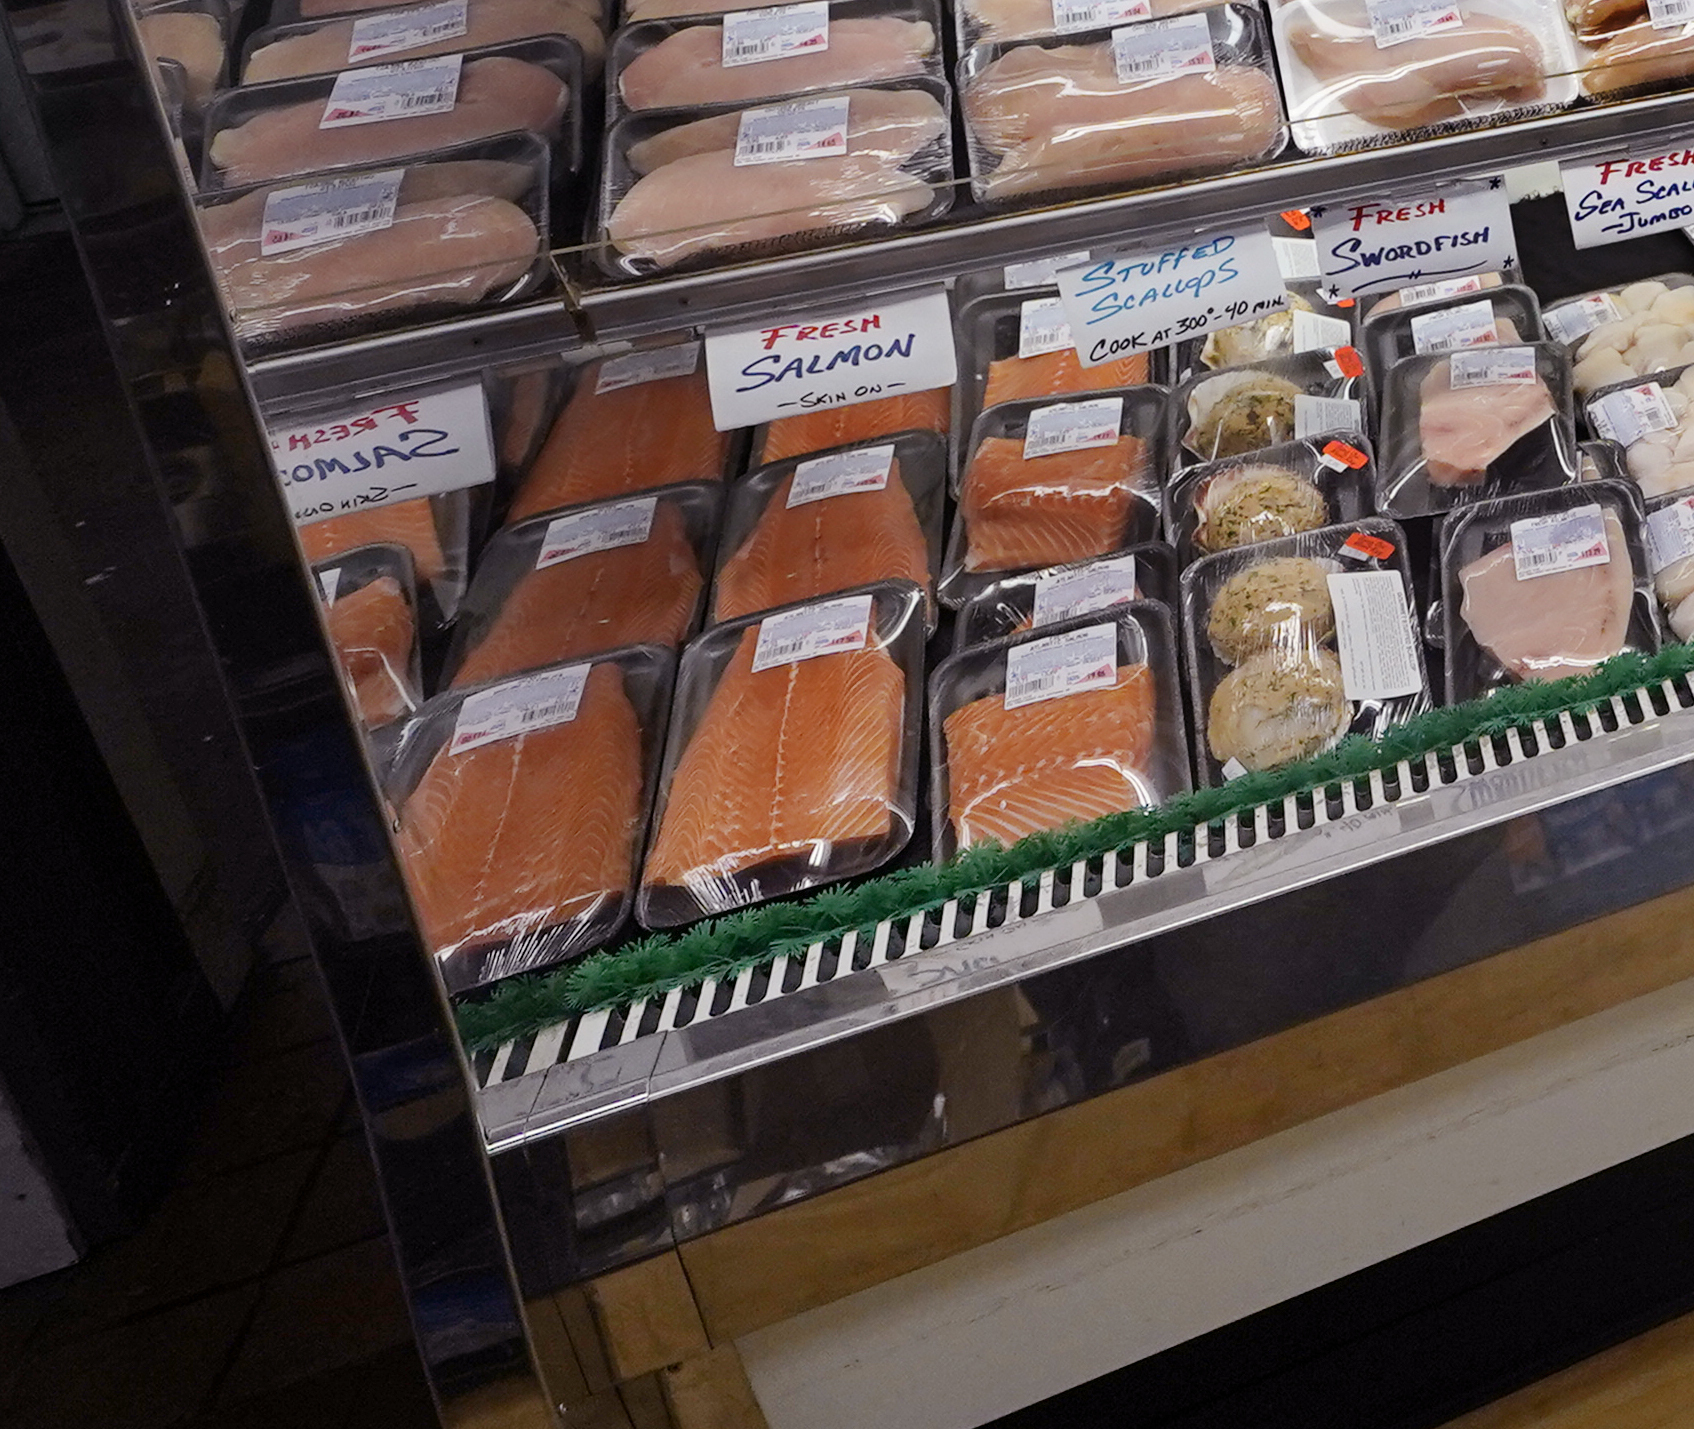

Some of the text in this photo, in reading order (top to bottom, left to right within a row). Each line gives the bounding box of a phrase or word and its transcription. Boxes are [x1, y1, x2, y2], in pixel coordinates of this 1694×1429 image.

[1348, 198, 1446, 231] FRESH
[1575, 190, 1625, 221] SEA
[1076, 235, 1235, 298] STUFFED
[1325, 226, 1491, 277] SWORDFISH
[1086, 258, 1239, 326] SCALLOPS
[761, 314, 882, 350] FRESH
[1088, 331, 1146, 363] COOK
[1151, 328, 1172, 343] AT
[1252, 295, 1285, 315] MIN.
[736, 333, 916, 393] SALMON
